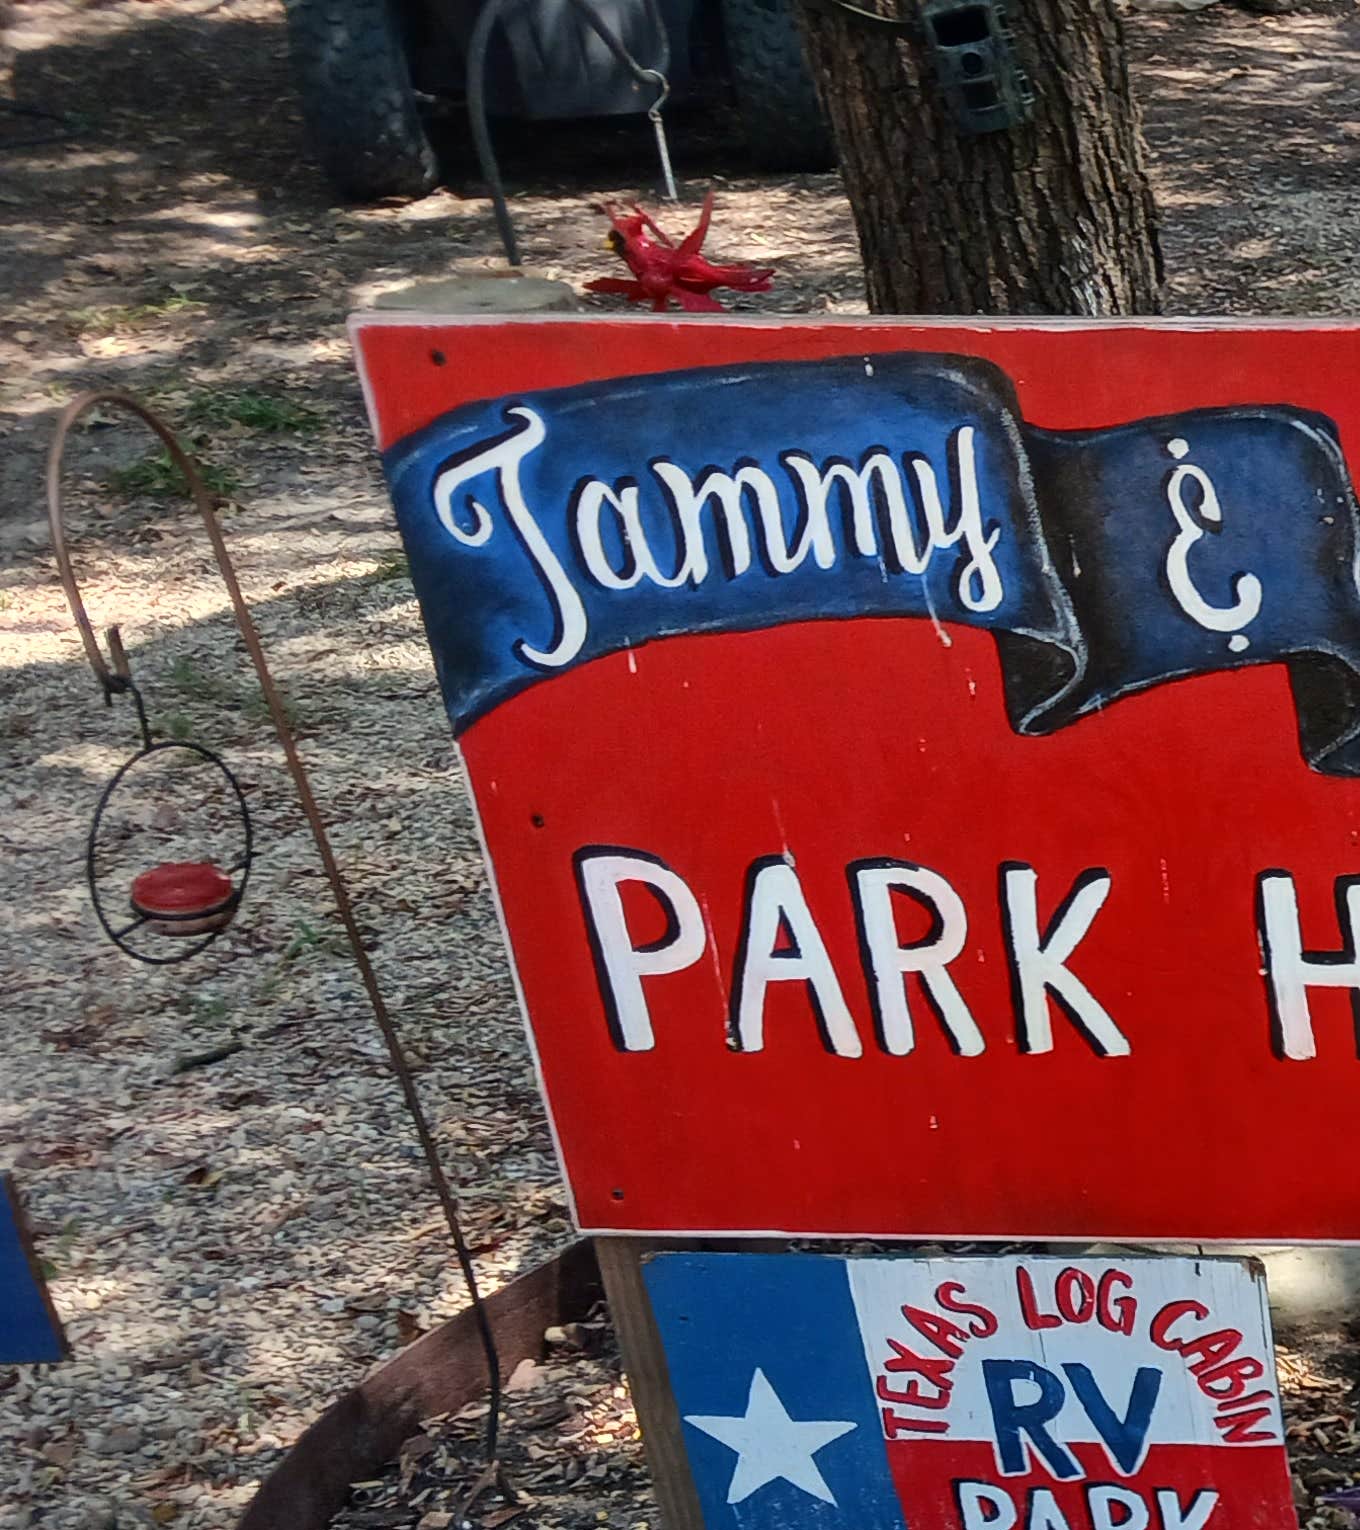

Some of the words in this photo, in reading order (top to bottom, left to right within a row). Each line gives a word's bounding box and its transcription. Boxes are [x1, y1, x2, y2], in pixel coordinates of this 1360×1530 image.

[433, 405, 1003, 670] Tammy
[1165, 436, 1263, 653] &
[575, 846, 1131, 1061] PARK
[877, 1280, 1000, 1440] TEXAS
[1016, 1265, 1134, 1337] LOG
[1150, 1299, 1276, 1444] CABIN
[981, 1358, 1163, 1479] RV
